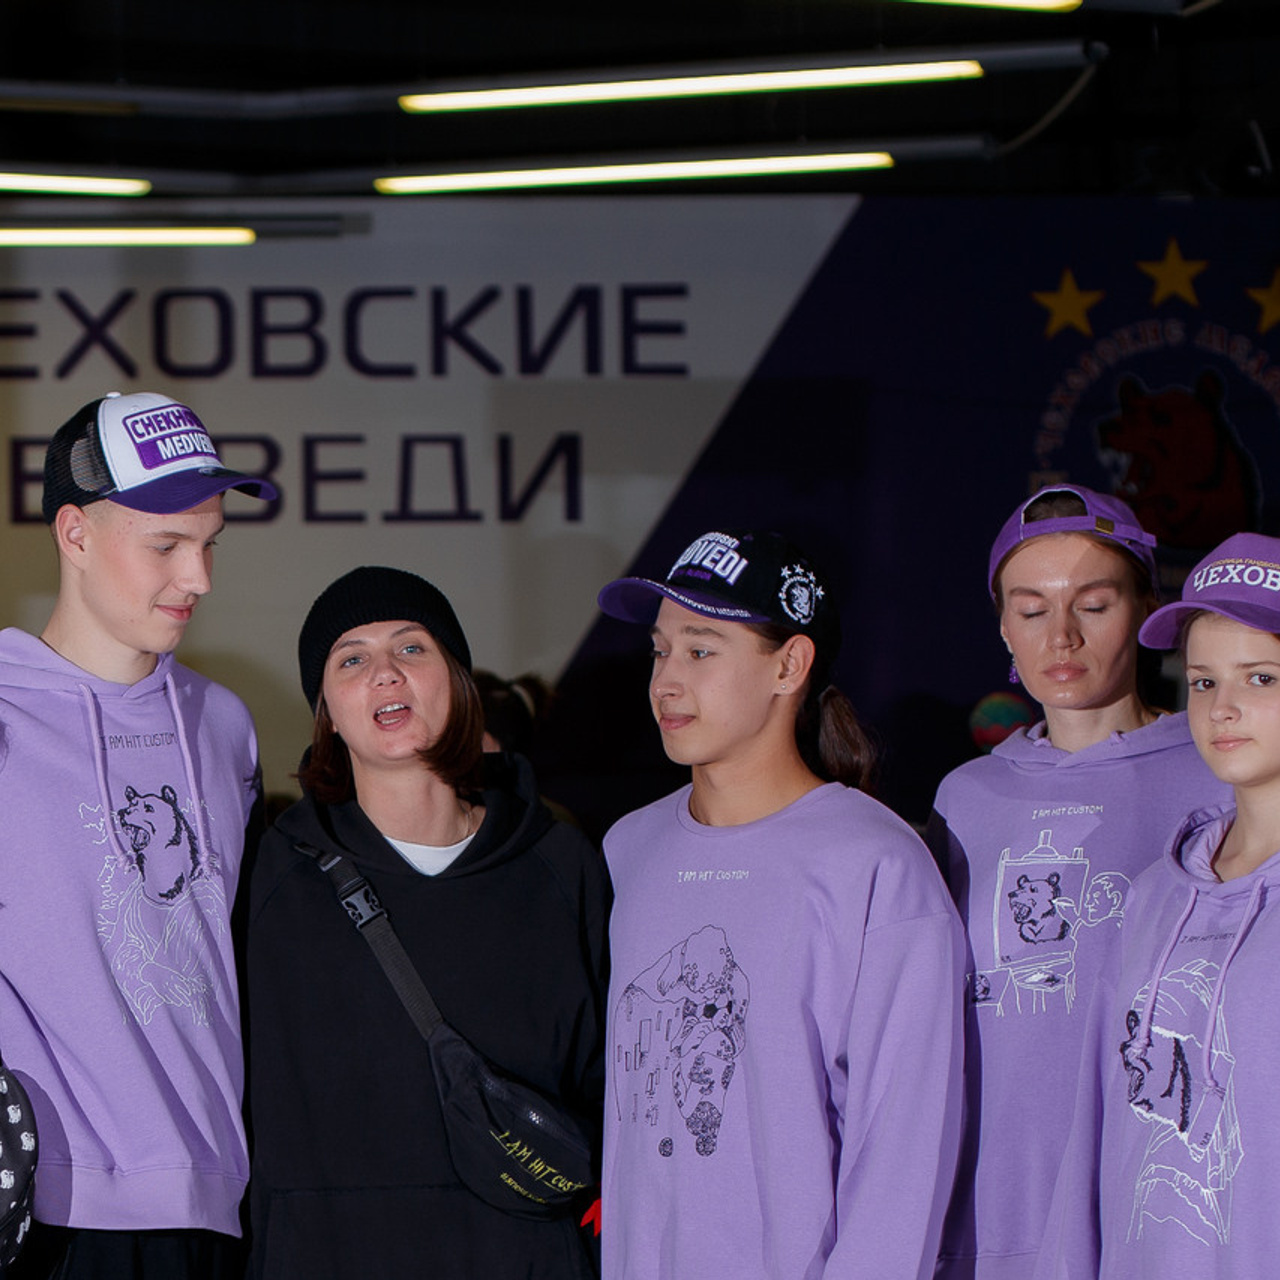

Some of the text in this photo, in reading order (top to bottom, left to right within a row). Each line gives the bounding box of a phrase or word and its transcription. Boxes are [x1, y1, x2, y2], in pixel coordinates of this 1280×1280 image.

[1193, 563, 1280, 592] ЧЕХОВ
[108, 734, 125, 749] AM
[125, 733, 141, 749] HIT
[143, 731, 178, 748] CUSTOM
[1067, 804, 1104, 816] CUSTOM
[716, 869, 749, 880] CUSTOM
[505, 1140, 535, 1163] AM
[528, 1157, 559, 1182] HIT
[551, 1174, 588, 1192] CUST
